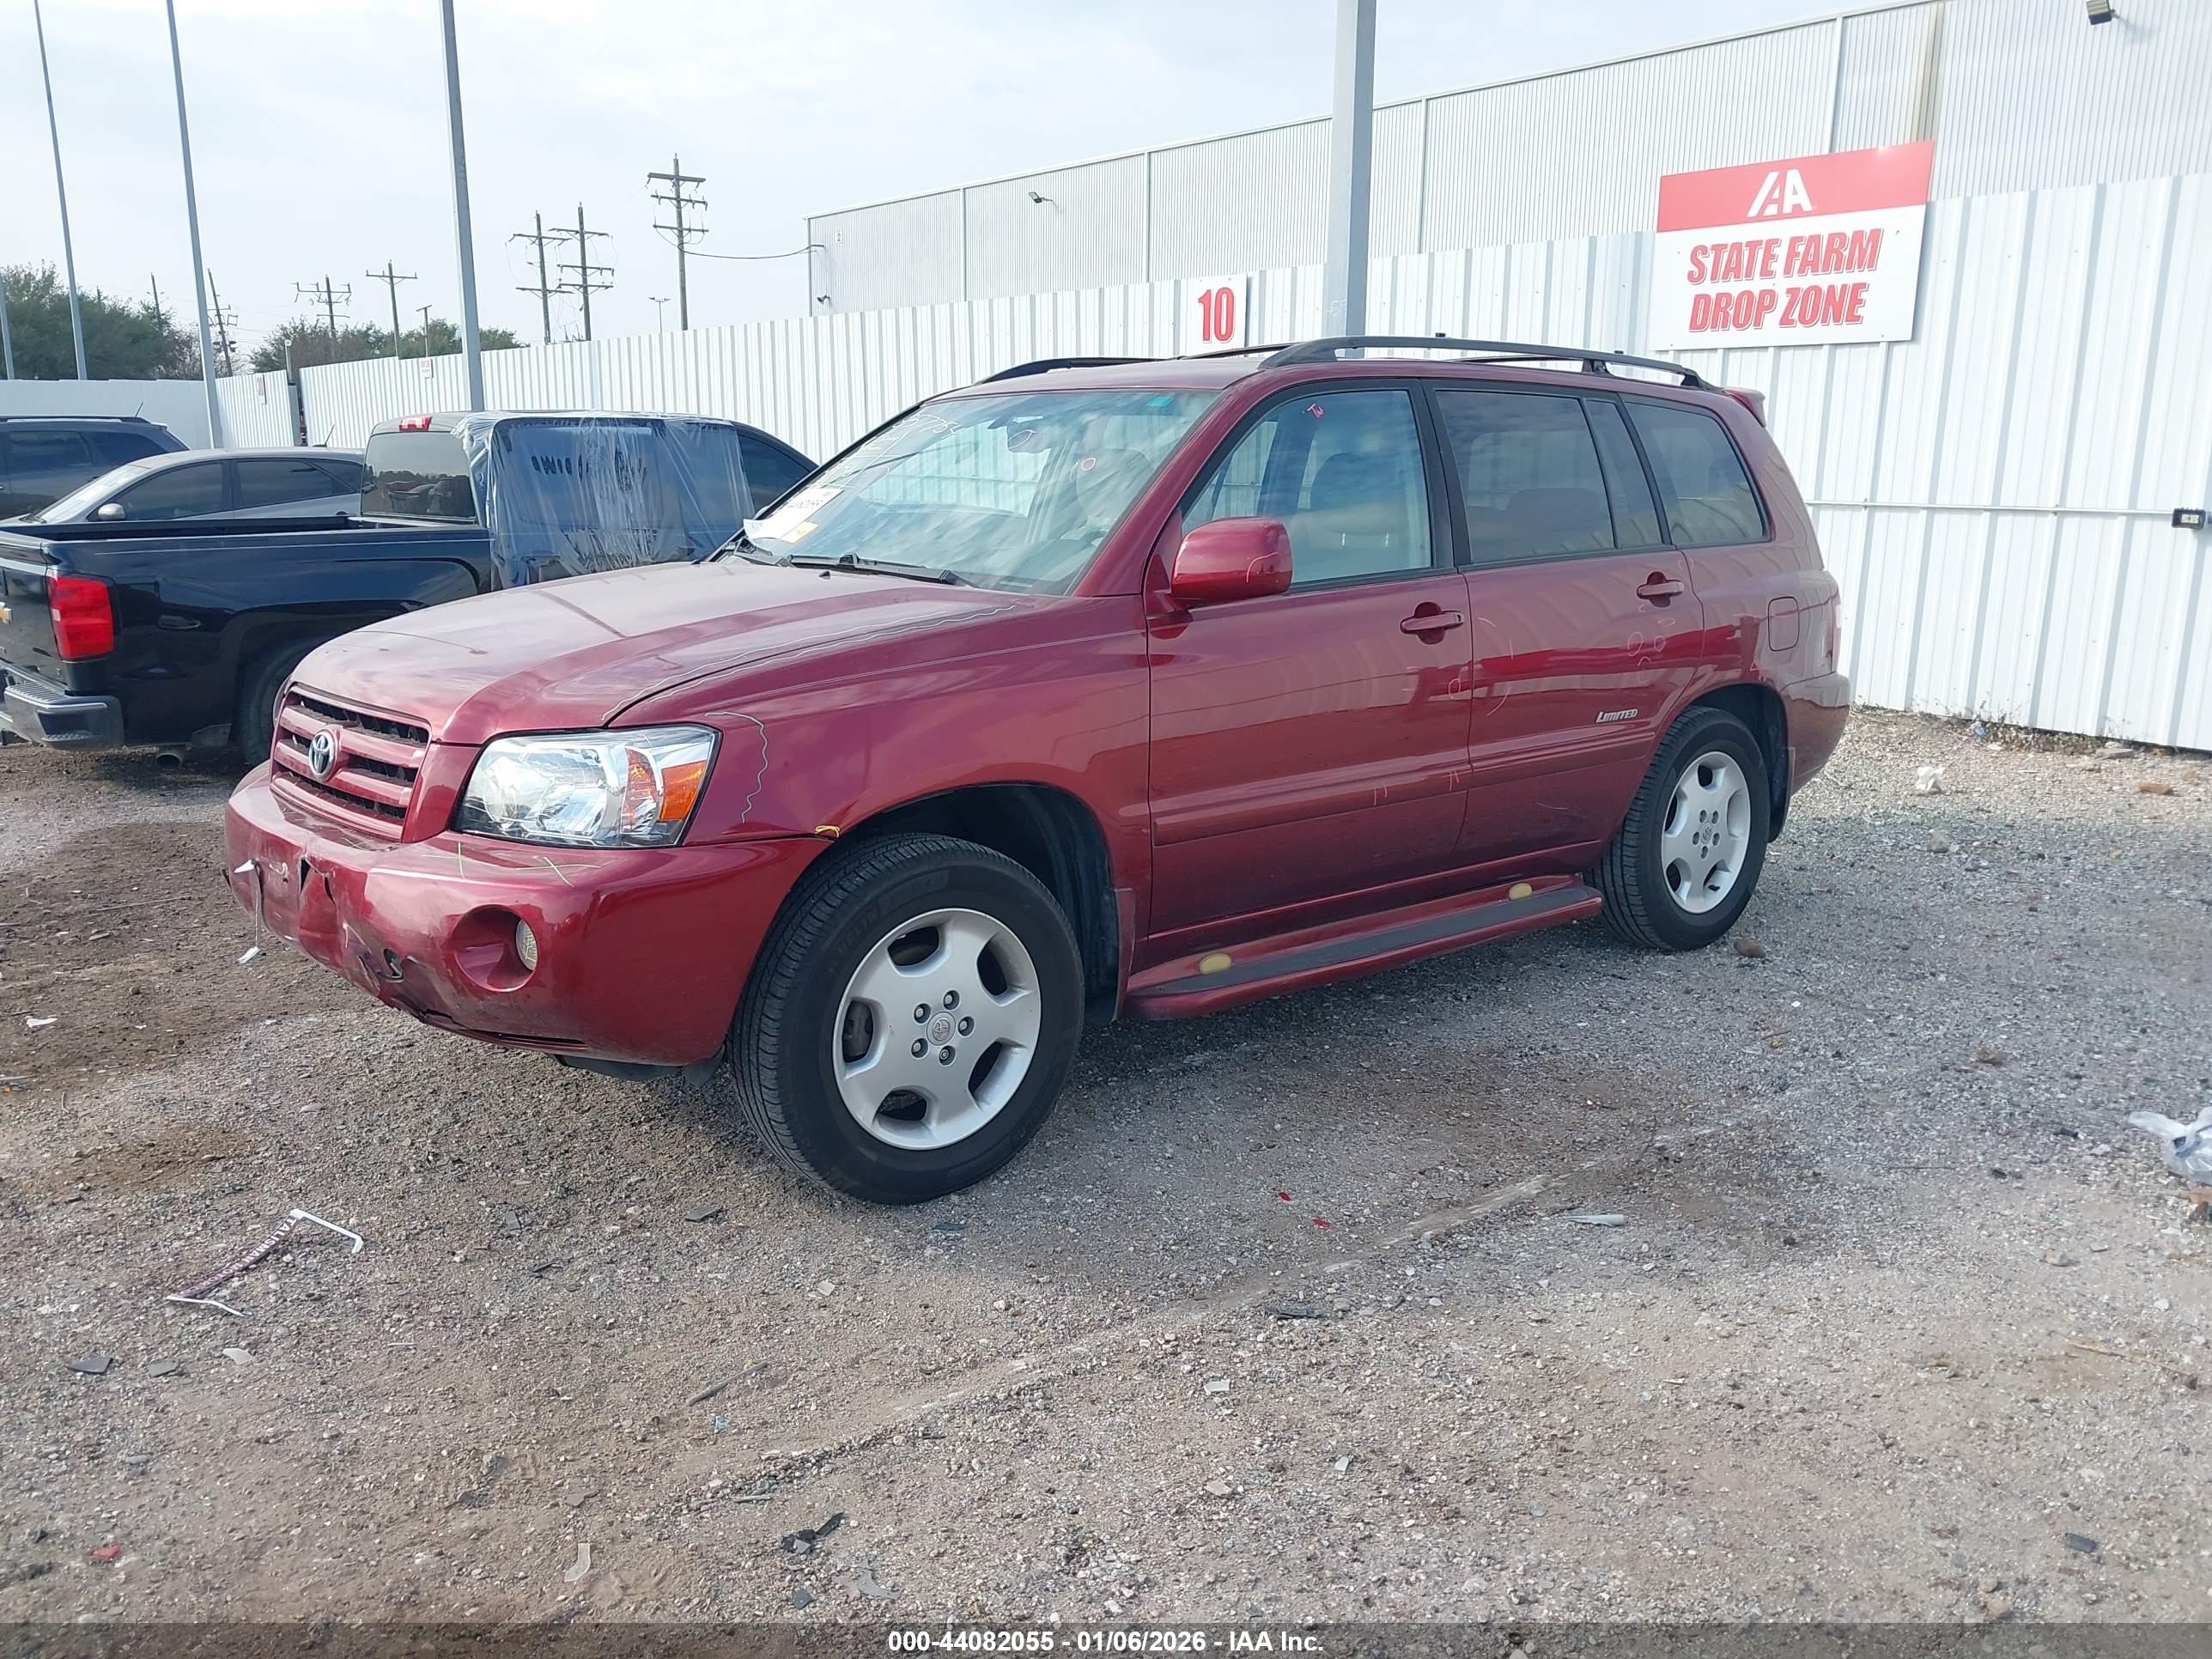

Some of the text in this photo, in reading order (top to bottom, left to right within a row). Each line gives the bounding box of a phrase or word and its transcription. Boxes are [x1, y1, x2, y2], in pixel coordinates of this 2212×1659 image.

[1686, 228, 1884, 285] STATE FARM
[1197, 287, 1236, 343] 10
[1688, 282, 1869, 332] DROP ZONE
[241, 1218, 297, 1264] TALISMAN
